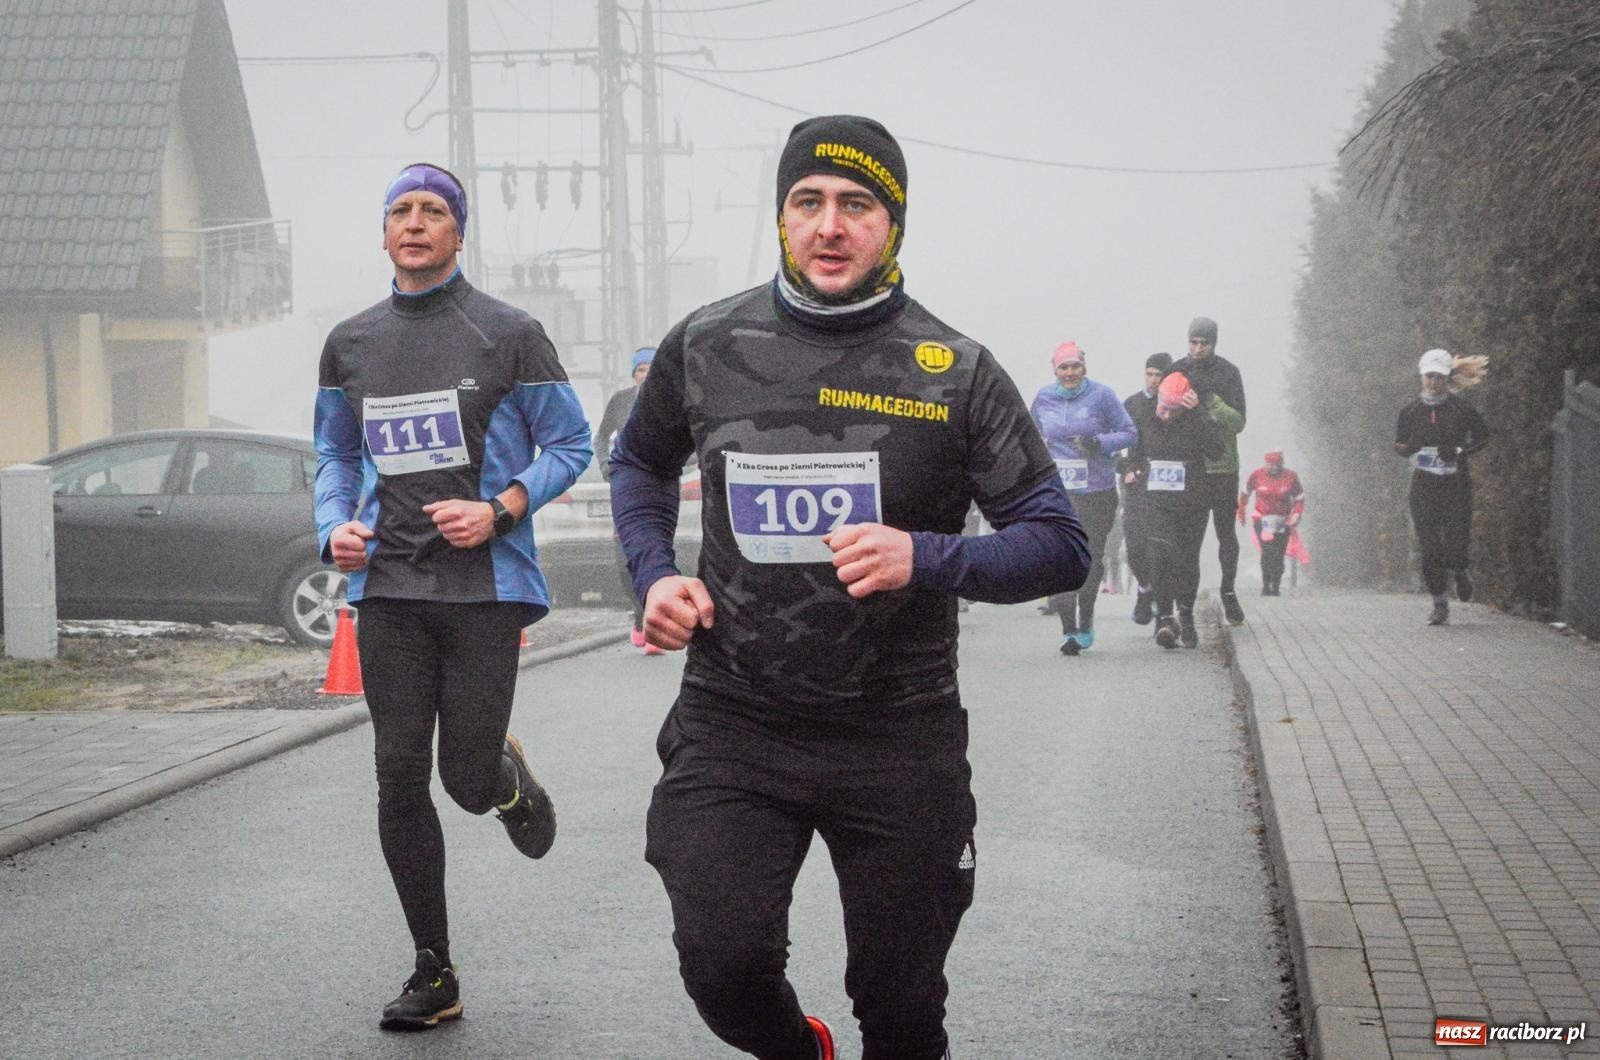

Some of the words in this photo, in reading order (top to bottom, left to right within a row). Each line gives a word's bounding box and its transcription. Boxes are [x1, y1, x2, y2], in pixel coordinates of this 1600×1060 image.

[815, 143, 905, 206] RUNMAGEDDON
[818, 387, 949, 422] RUNMAGEDDON
[379, 416, 446, 453] 111
[756, 463, 778, 471] Cross
[779, 464, 789, 472] po
[790, 462, 813, 470] Ziemi
[813, 461, 867, 471] Pietrowickiej
[1151, 469, 1177, 481] 146
[754, 487, 854, 533] 109
